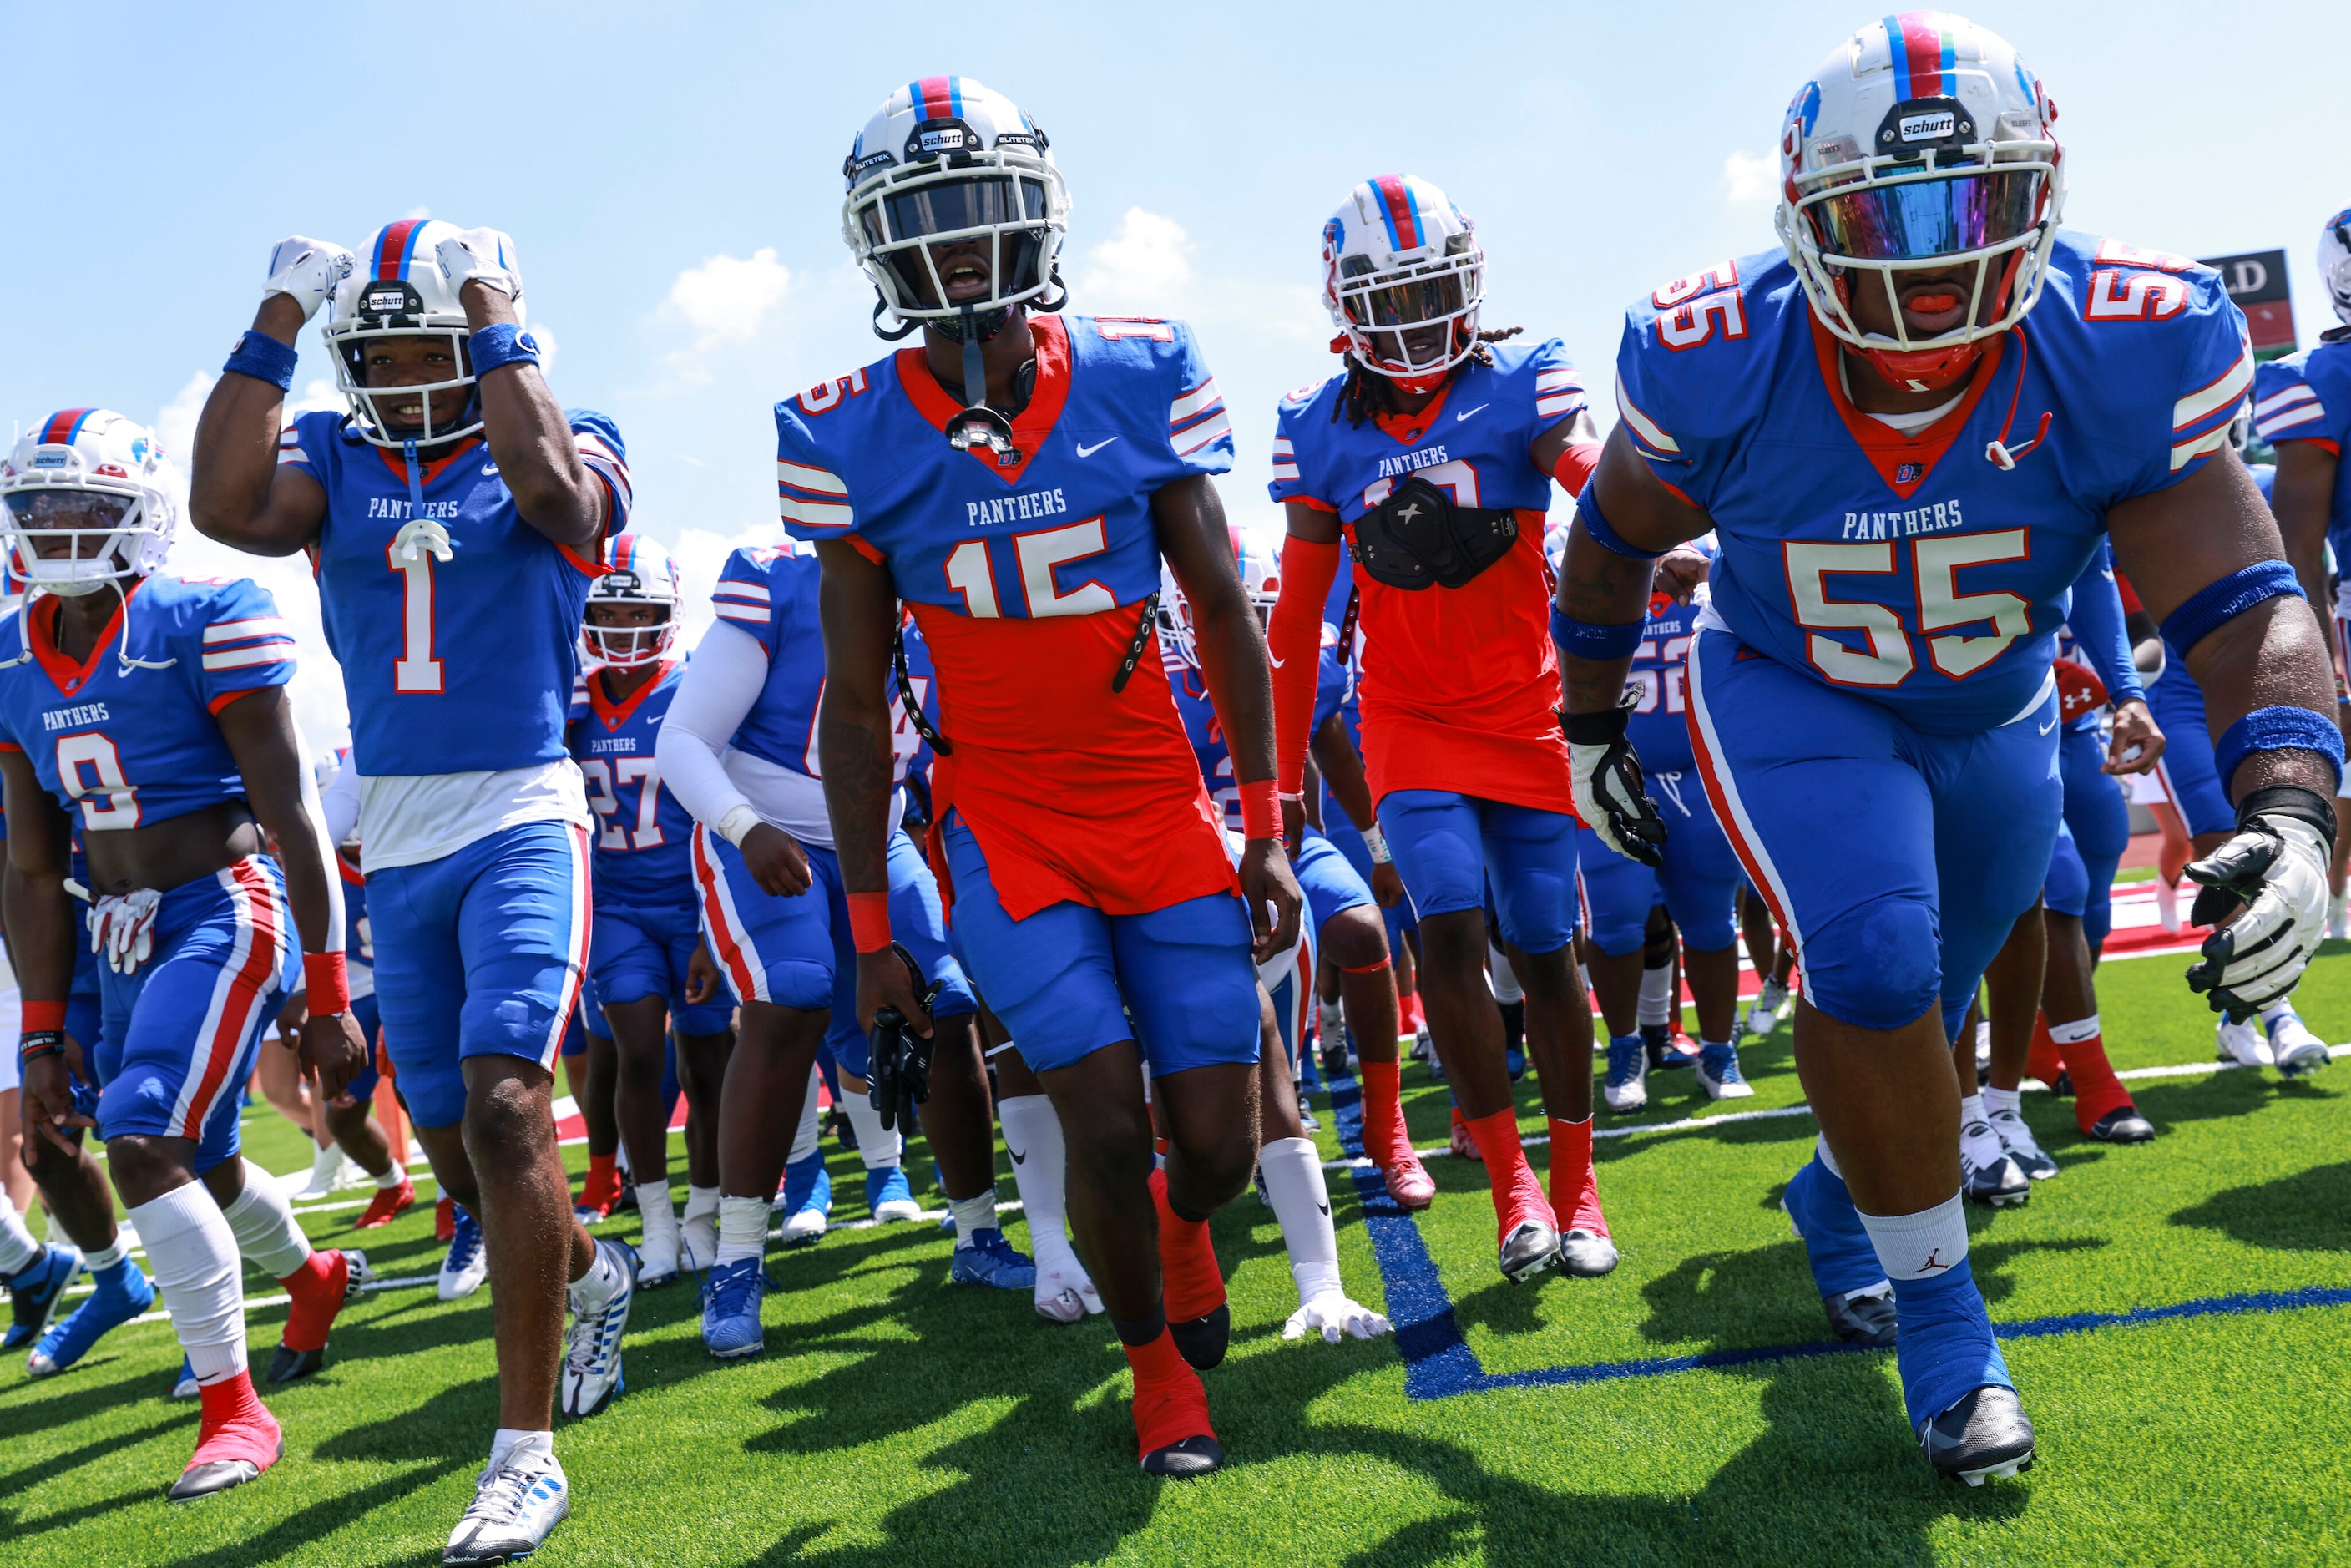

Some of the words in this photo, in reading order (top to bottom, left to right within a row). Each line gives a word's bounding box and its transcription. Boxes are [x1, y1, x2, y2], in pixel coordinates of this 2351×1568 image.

[923, 134, 961, 147] schutt
[999, 136, 1036, 144] ELITETEK
[1904, 119, 1952, 135] schutt
[371, 296, 403, 306] schutt
[1382, 445, 1449, 478] PANTHERS
[368, 498, 458, 519] PANTERS
[966, 488, 1067, 526] PANTHERS
[1843, 500, 1963, 540] PANTHERS
[942, 514, 1119, 620] 15
[385, 526, 445, 695] 1
[1781, 527, 2034, 688] 55
[43, 703, 109, 731] PANTHERS
[591, 738, 636, 753] PANTHERS
[56, 730, 143, 832] 9
[580, 757, 667, 851] 27
